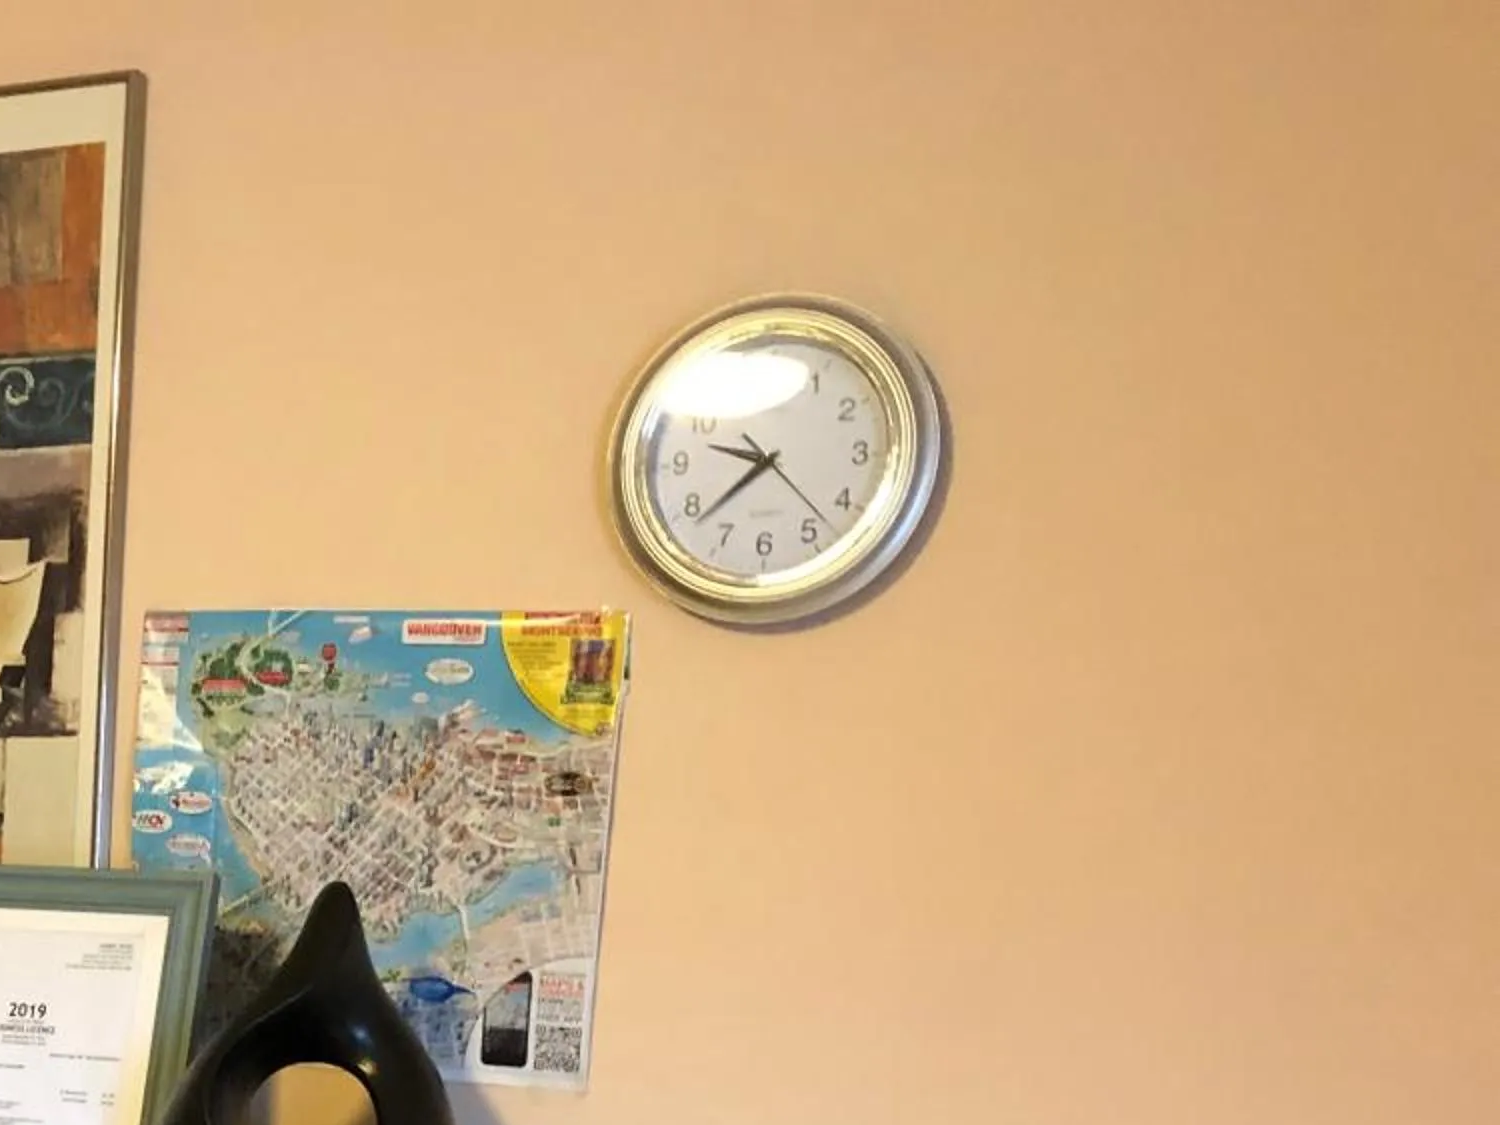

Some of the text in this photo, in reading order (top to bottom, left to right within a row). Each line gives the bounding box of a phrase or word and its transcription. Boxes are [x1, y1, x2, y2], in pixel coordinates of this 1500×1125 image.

[811, 373, 821, 395] 1
[837, 397, 856, 422] 2
[672, 451, 689, 475] 9
[851, 440, 869, 466] 3
[683, 493, 701, 517] 8
[835, 487, 852, 511] 4
[717, 524, 735, 547] 7
[800, 518, 818, 544] 5
[756, 532, 773, 557] 6
[8, 1001, 48, 1019] 2019
